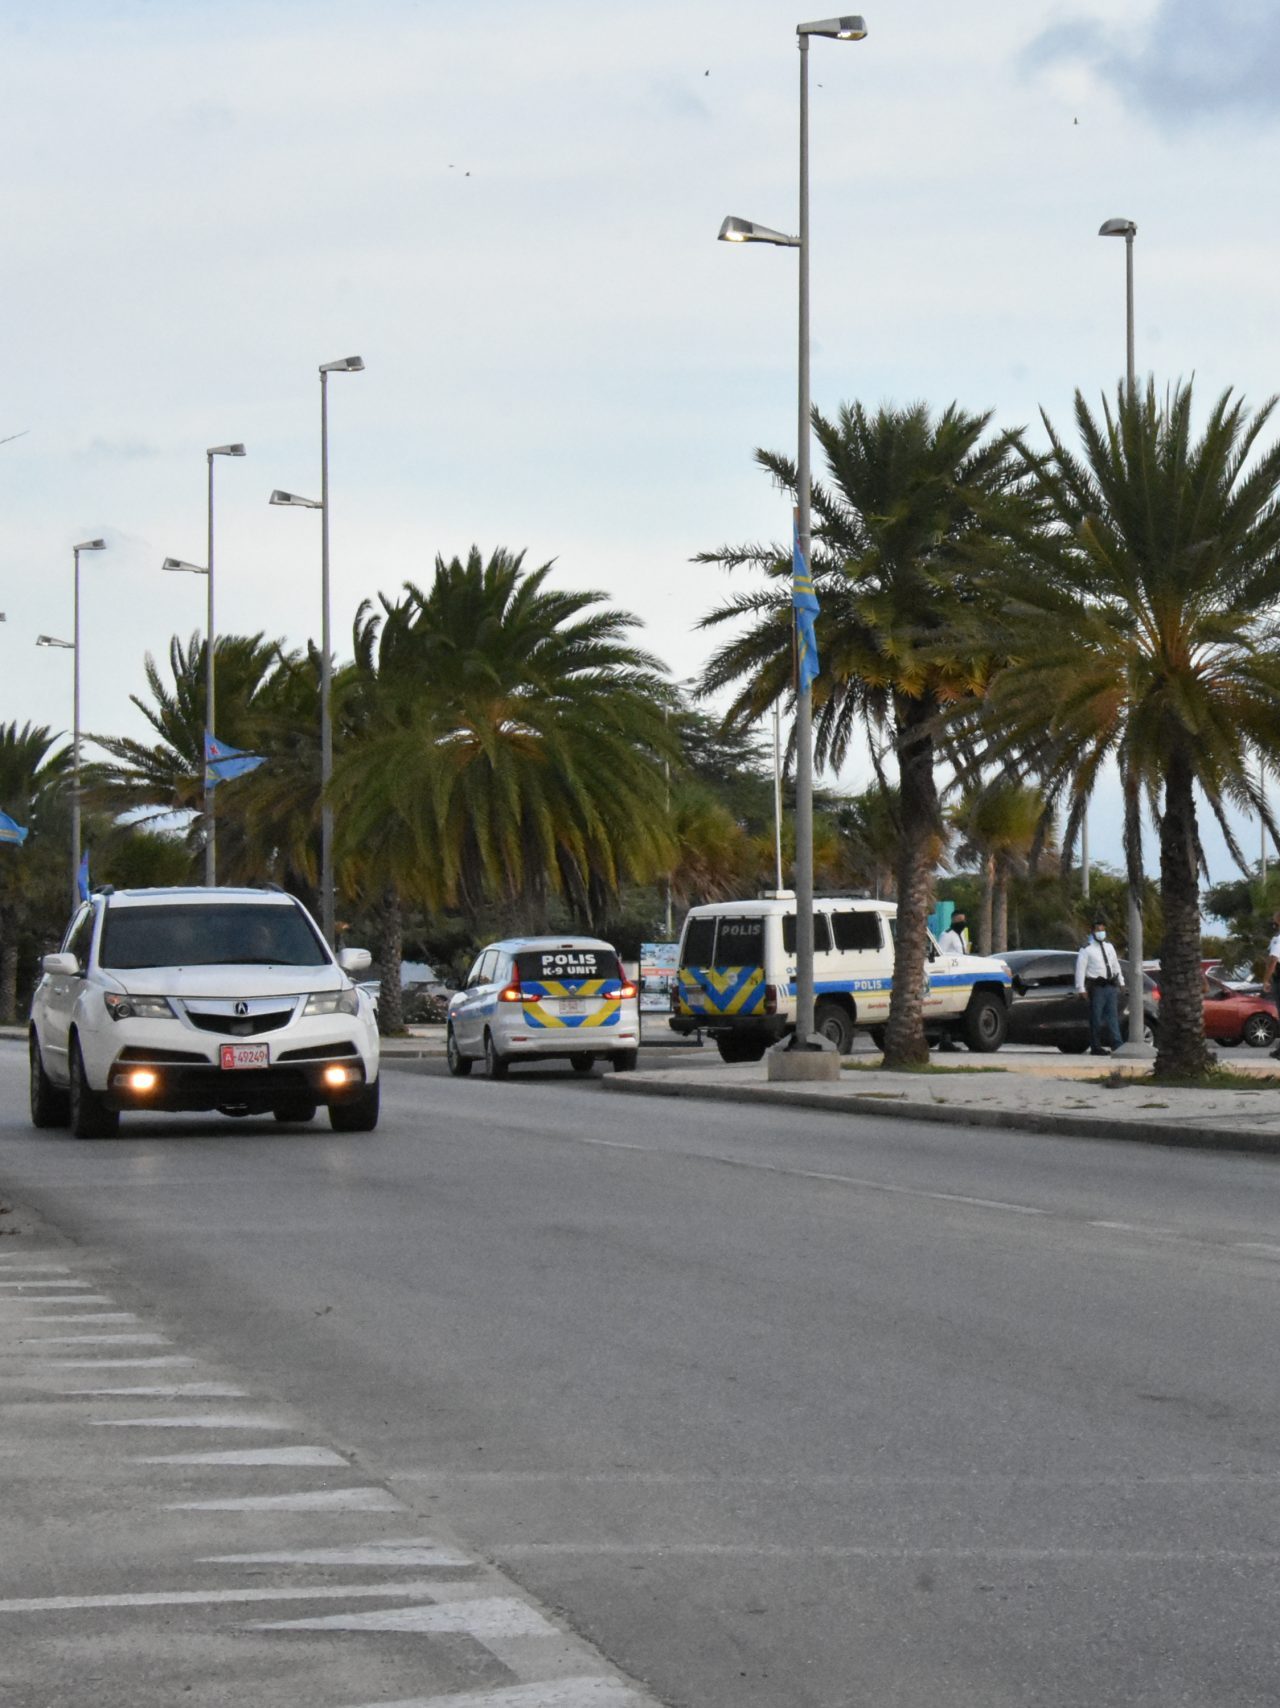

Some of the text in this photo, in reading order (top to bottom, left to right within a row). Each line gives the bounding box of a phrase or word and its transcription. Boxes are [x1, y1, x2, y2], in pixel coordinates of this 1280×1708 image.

[721, 924, 761, 936] POLIS
[541, 954, 596, 966] POLIS
[542, 966, 597, 976] K-9 UNIT
[854, 980, 882, 990] POLIS
